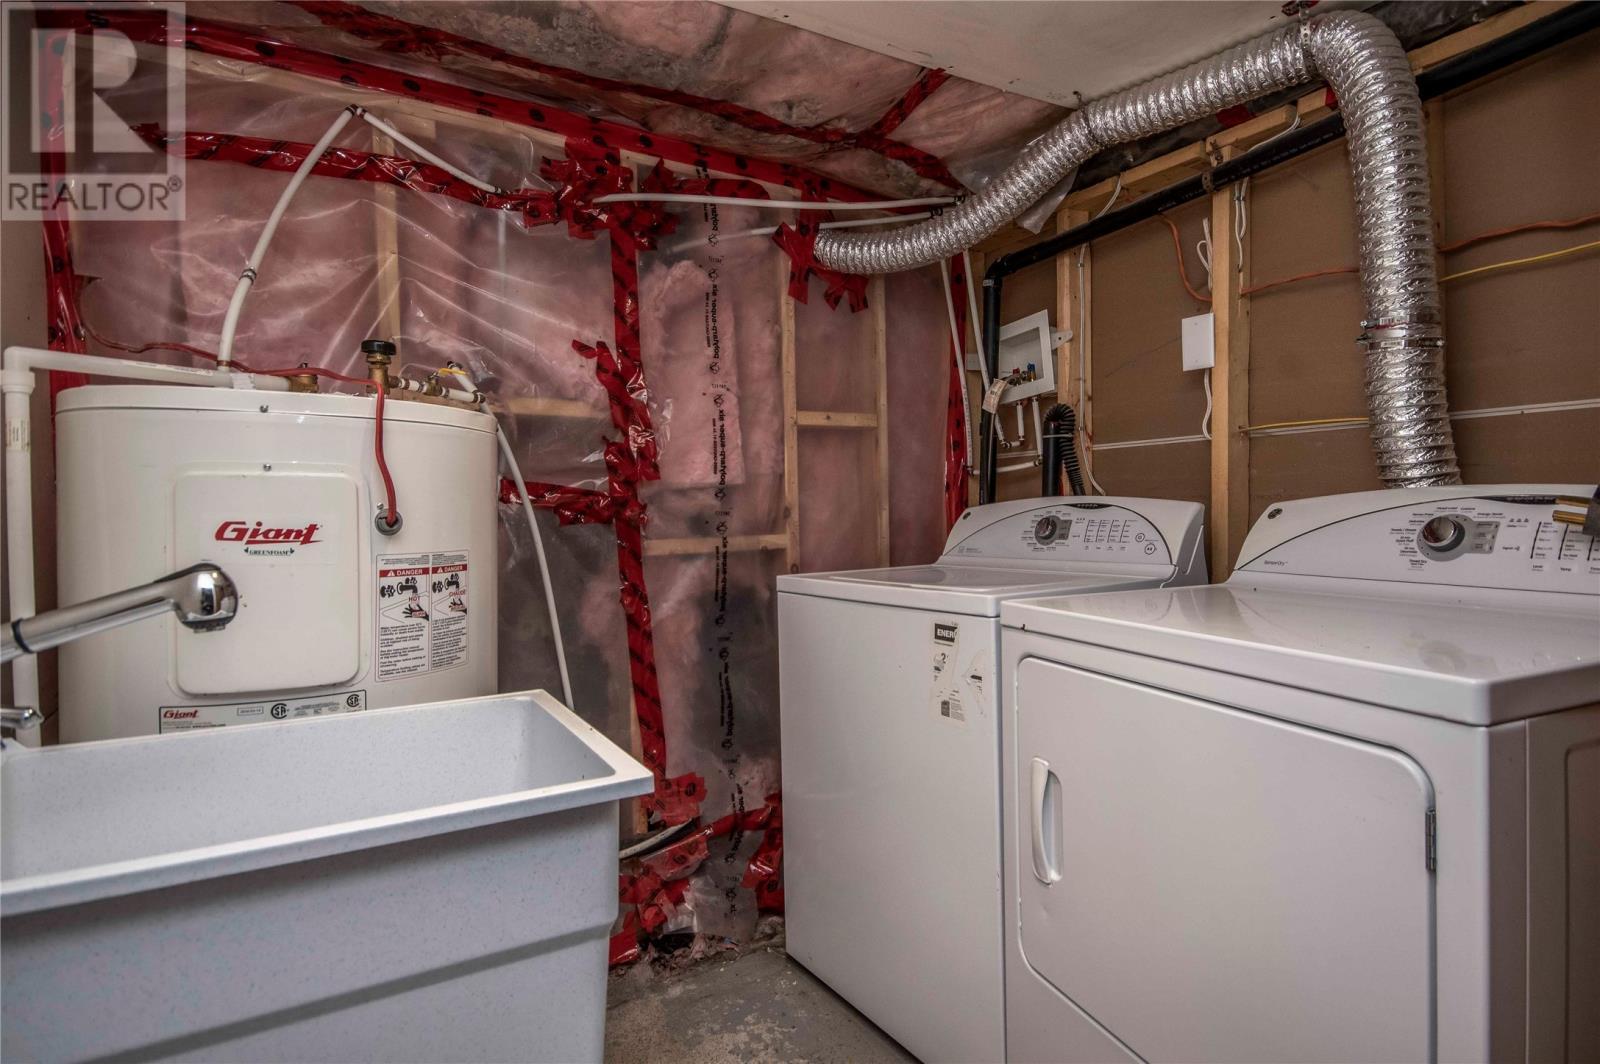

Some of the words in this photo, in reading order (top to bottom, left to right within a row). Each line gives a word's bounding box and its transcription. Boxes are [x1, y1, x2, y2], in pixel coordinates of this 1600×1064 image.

[215, 521, 321, 545] Giant
[937, 628, 955, 638] ENER
[163, 710, 198, 719] Giant
